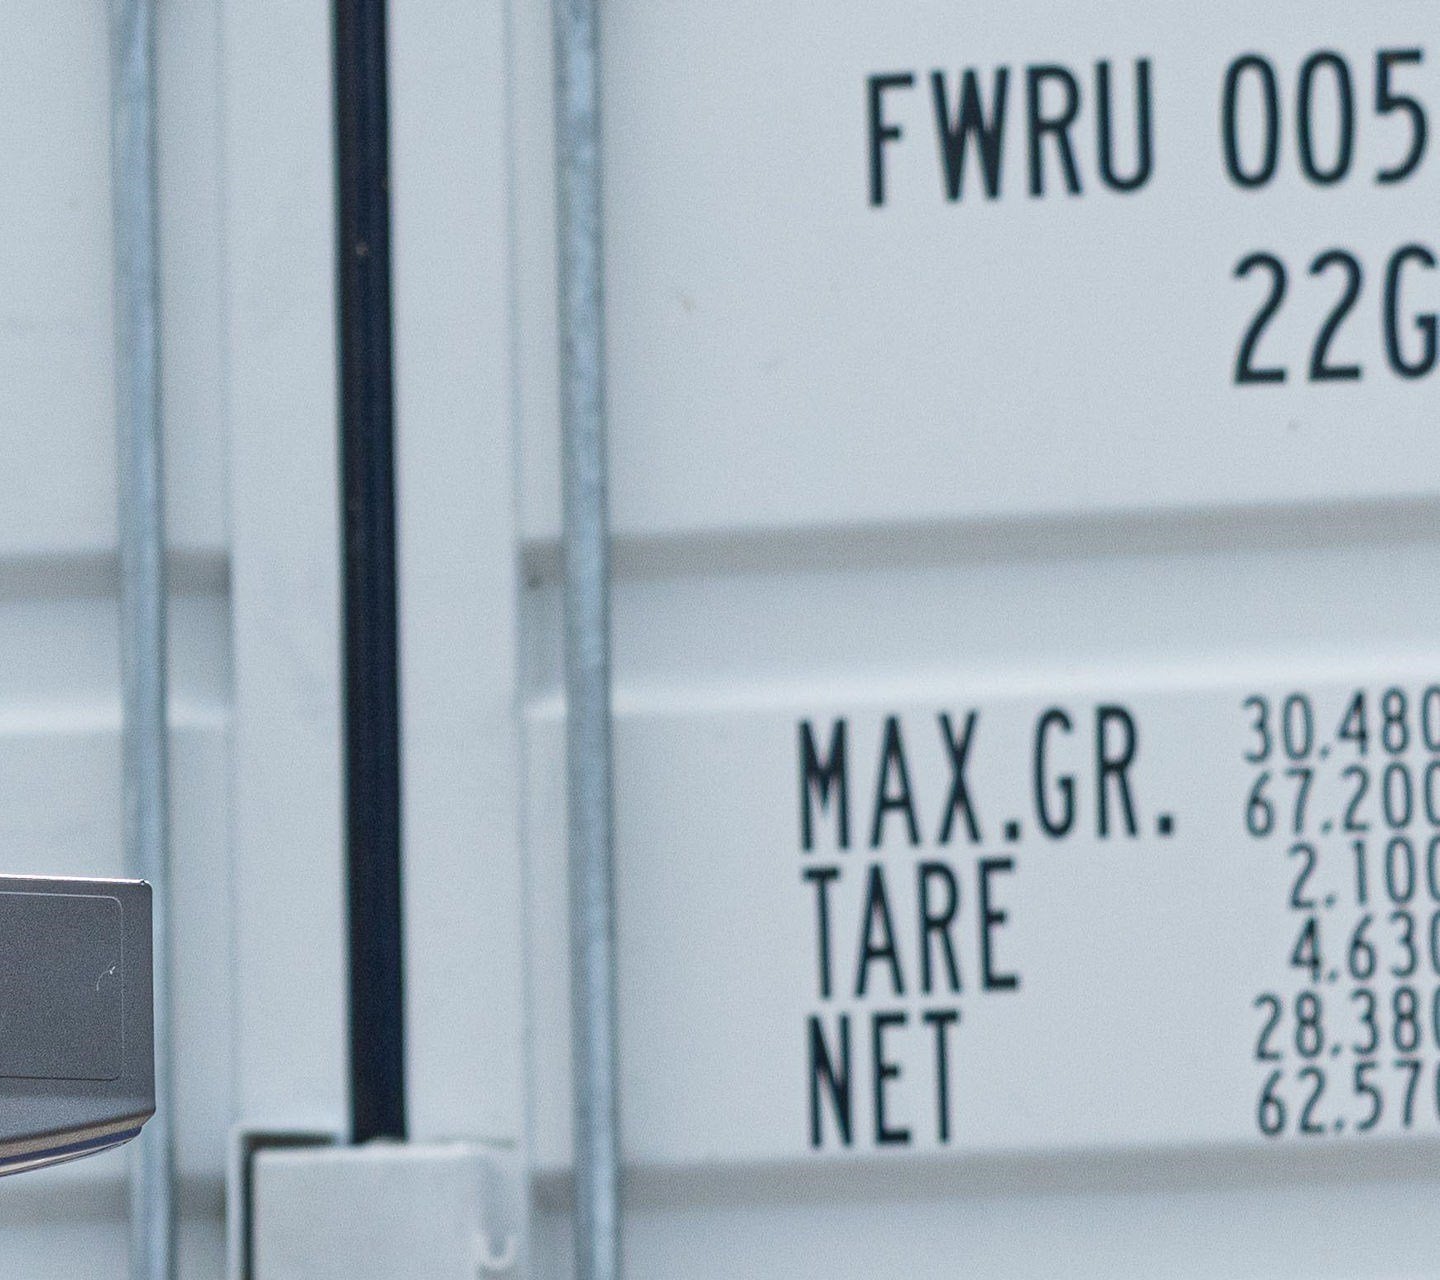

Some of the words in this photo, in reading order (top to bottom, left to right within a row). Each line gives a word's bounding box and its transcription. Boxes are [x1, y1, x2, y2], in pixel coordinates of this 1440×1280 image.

[865, 56, 1155, 209] FWRU
[1220, 47, 1430, 192] 005
[1232, 242, 1440, 387] 22G
[800, 855, 1021, 1002] TARE
[806, 1007, 962, 1151] NET
[1253, 985, 1440, 1061] 28.38
[1259, 1058, 1440, 1135] 62.57
